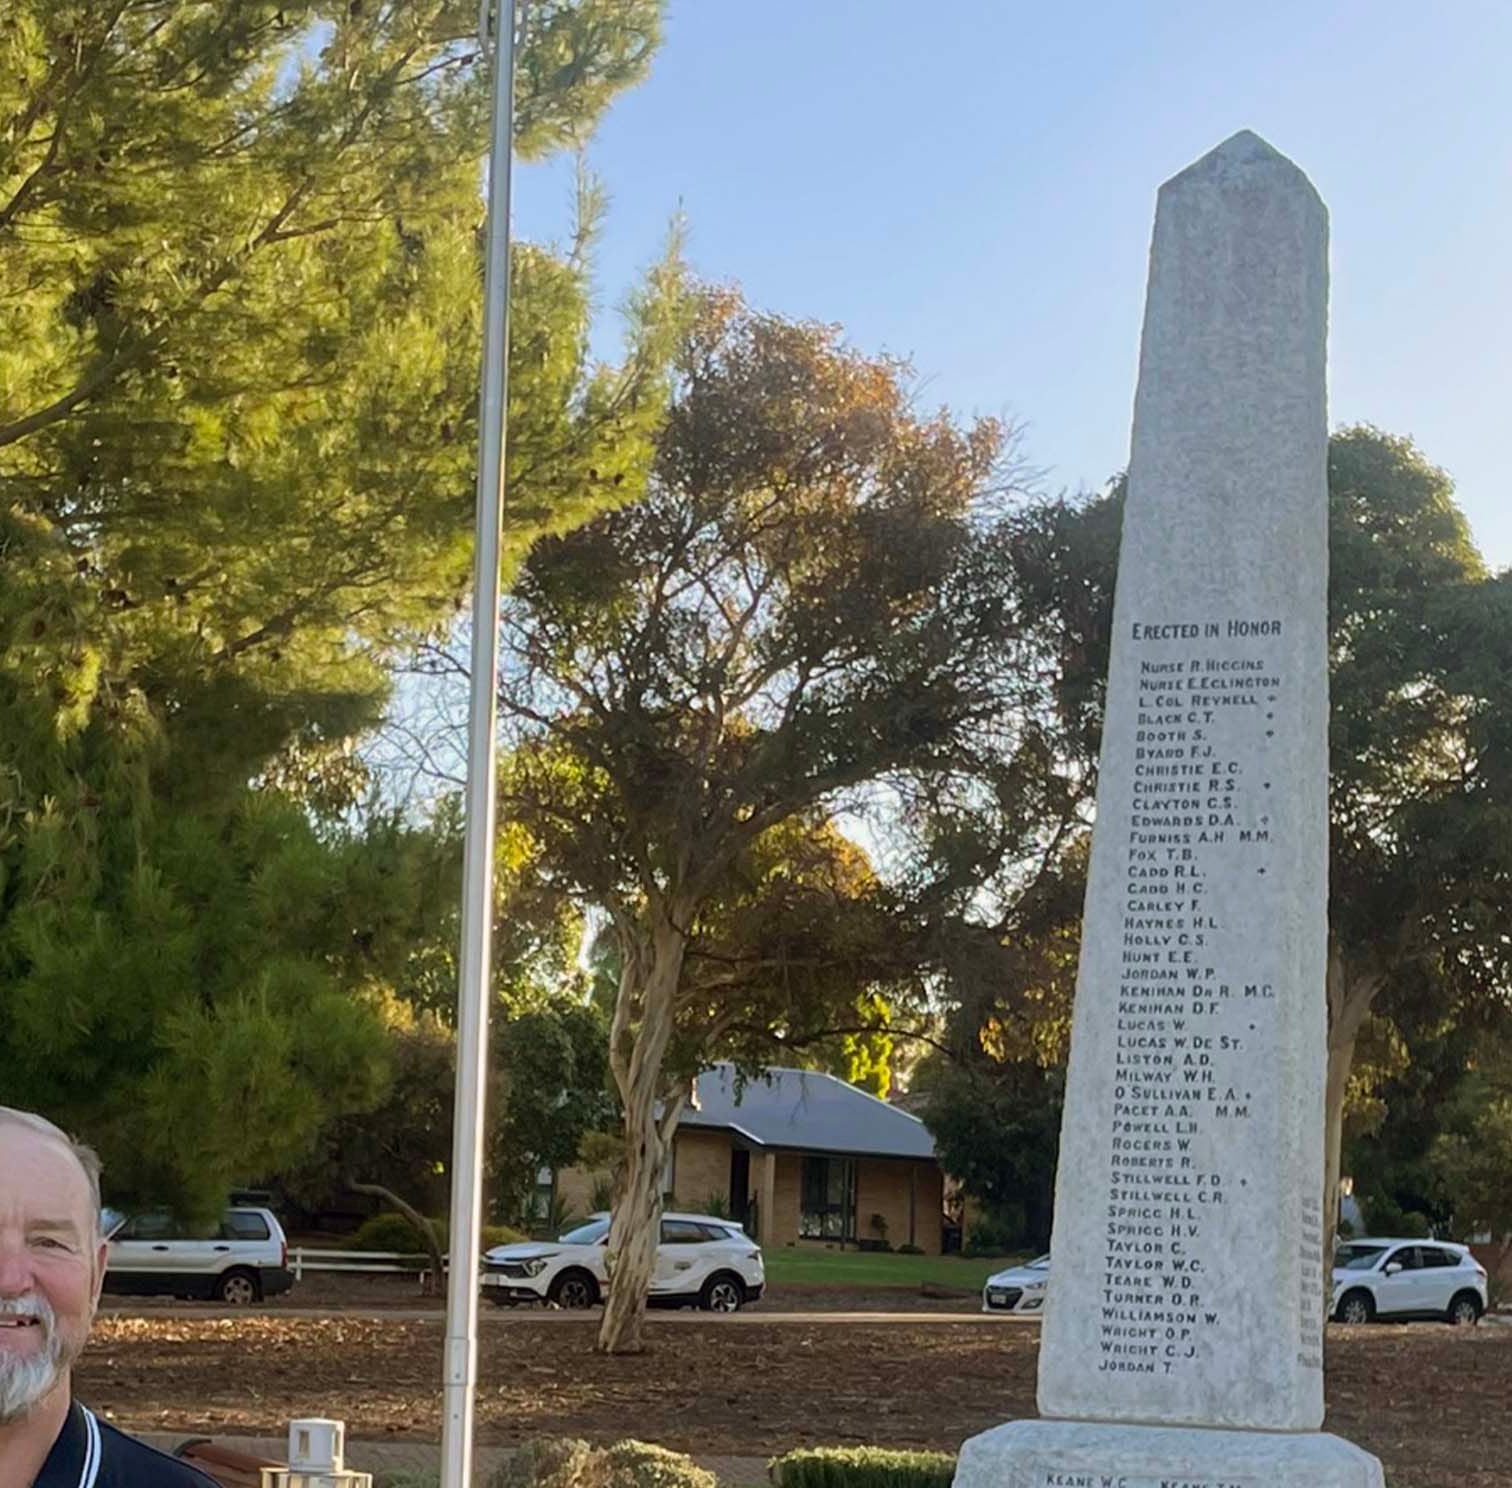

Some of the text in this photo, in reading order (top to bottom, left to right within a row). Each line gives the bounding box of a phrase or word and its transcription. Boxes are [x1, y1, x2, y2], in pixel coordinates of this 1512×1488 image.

[1132, 620, 1281, 640] ERECTED IN HONOR
[1141, 661, 1184, 674] NURSE
[1140, 679, 1183, 691] NURSE
[1138, 713, 1182, 725] BLACK
[1137, 731, 1186, 741] BOOTH
[1136, 748, 1184, 759] BYARD
[1135, 765, 1204, 776] CHRISTIE
[1133, 781, 1200, 793] CHRISTIE
[1132, 799, 1200, 810] CLAYTON
[1131, 815, 1203, 827] EDWARDS
[1129, 832, 1191, 844] FURNISS
[1129, 849, 1156, 861] FOX
[1128, 866, 1168, 878] CADD
[1127, 900, 1184, 912] CARLEY
[1124, 917, 1184, 929] HAYNES
[1123, 933, 1171, 946] HOLLY
[1122, 951, 1160, 963] HUNT
[1121, 968, 1178, 980] JORDAN
[1118, 1019, 1165, 1031] LUCAS
[1118, 1036, 1167, 1048] LUCAS
[1116, 1052, 1173, 1065] LISTON
[1115, 1069, 1172, 1082] MILWAY
[1112, 1122, 1169, 1133] POWELL
[1111, 1155, 1173, 1168] ROBERTS
[1111, 1172, 1190, 1185] STILLWELL
[1110, 1188, 1190, 1202] STILLWELL
[1106, 1239, 1162, 1253] TAYLOR
[1105, 1256, 1163, 1270] TAYLOR
[1104, 1273, 1152, 1287] TEARE
[1103, 1289, 1163, 1304] TURNER
[1102, 1307, 1196, 1323] WILLIAMSON
[1098, 1360, 1154, 1373] JORDAN
[1046, 1474, 1094, 1488] KEANE
